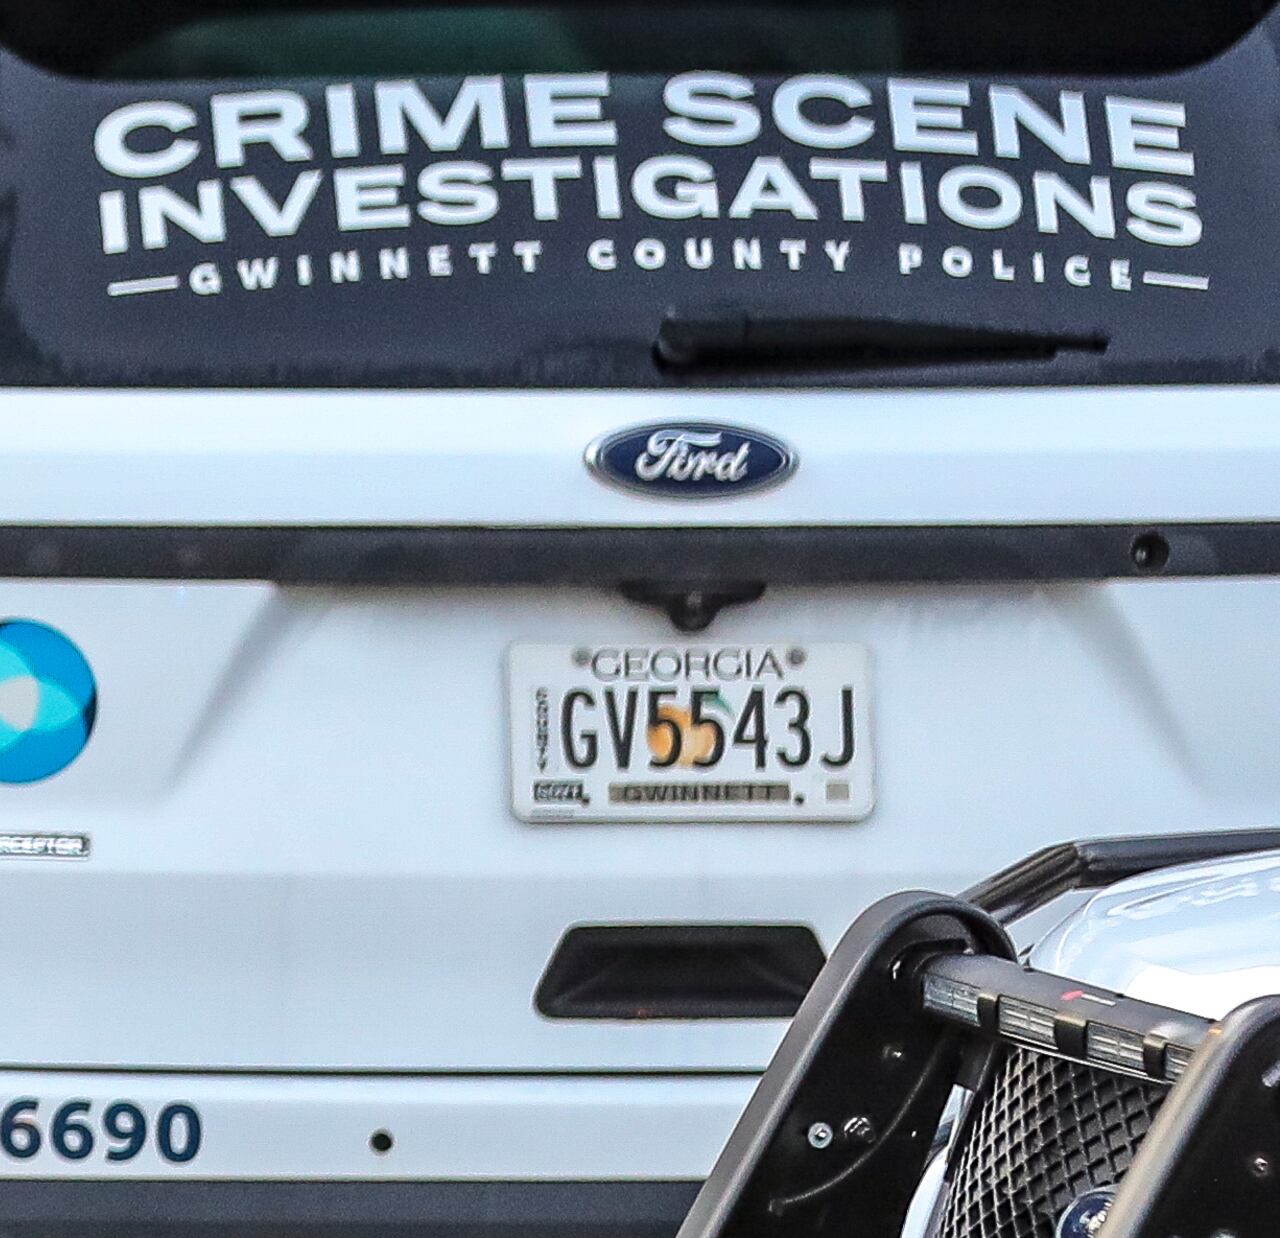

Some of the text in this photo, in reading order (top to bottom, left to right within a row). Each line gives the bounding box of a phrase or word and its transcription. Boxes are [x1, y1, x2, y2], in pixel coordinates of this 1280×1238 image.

[93, 73, 1196, 179] CRIME SCENE
[98, 154, 1204, 256] INVESTIGATIONS
[188, 238, 1133, 296] GWINNETT COUNTY POLICE
[635, 429, 749, 482] Ford
[591, 646, 785, 682] GEORGIA
[560, 686, 856, 770] GV5543J
[623, 781, 777, 801] GWINNETT
